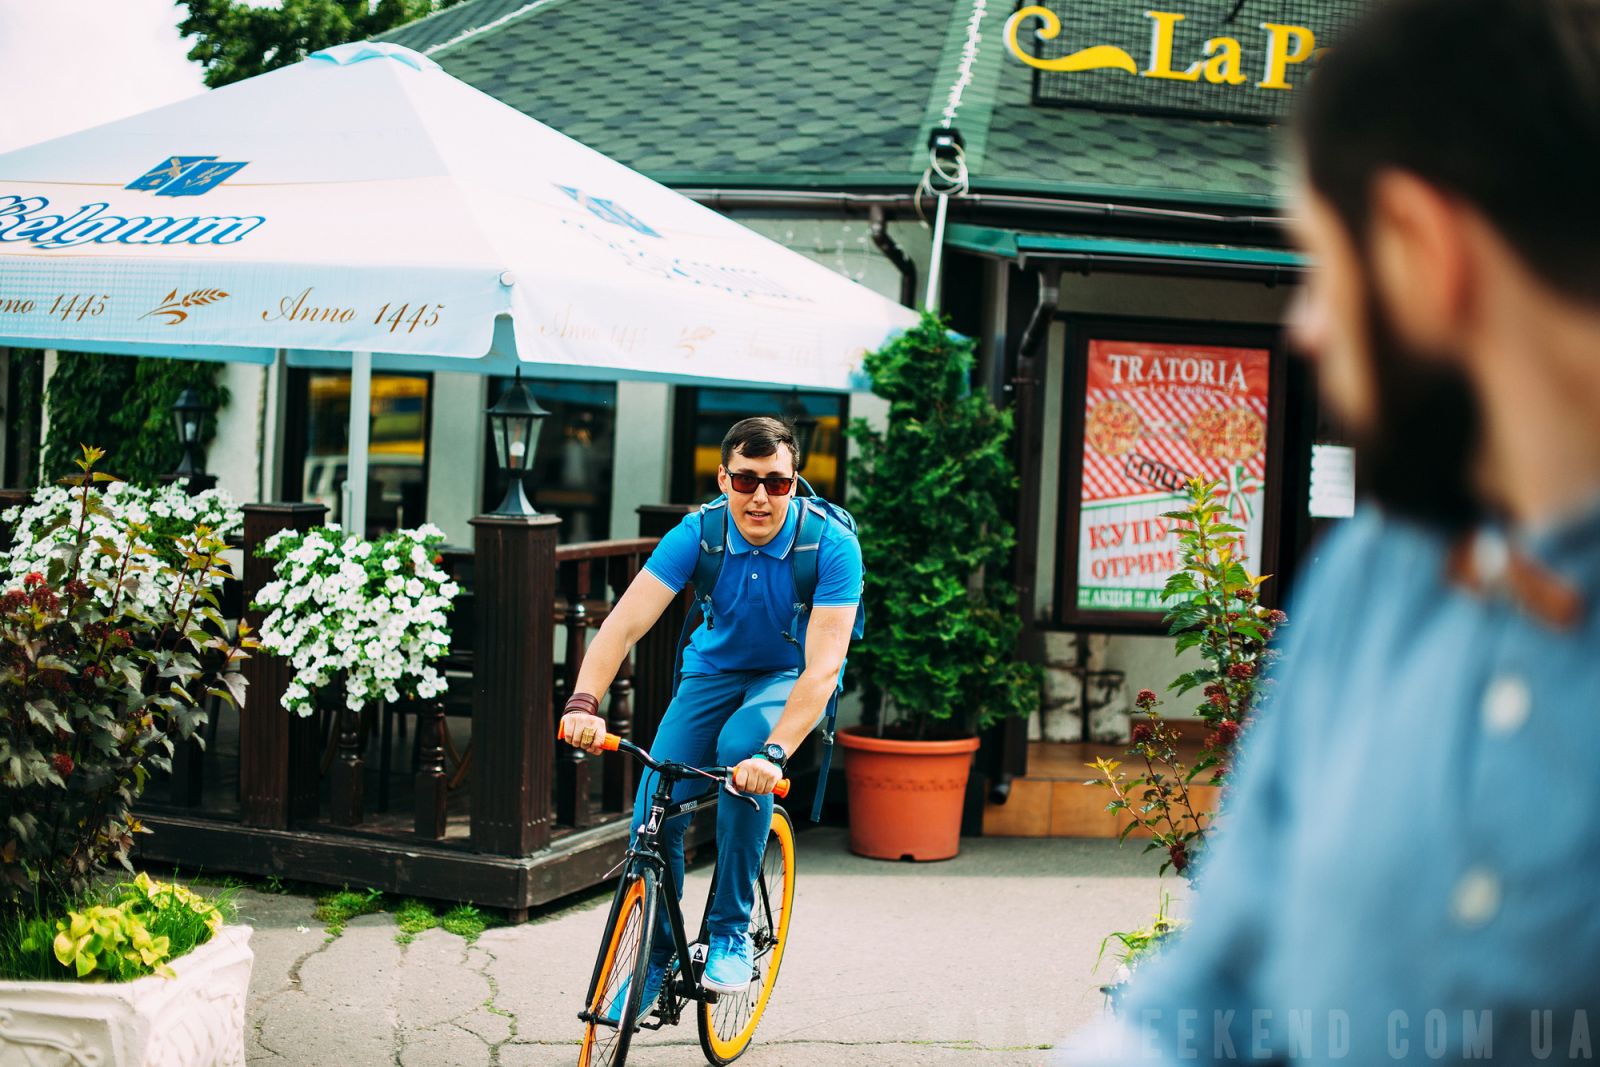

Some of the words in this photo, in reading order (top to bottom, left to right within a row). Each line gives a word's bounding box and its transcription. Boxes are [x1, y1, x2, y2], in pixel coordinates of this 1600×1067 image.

[1141, 10, 1247, 85] La
[1256, 22, 1330, 91] P
[49, 293, 110, 322] 1445
[262, 286, 357, 323] Anno
[374, 302, 446, 333] 1445
[1108, 354, 1248, 391] TRATORIA
